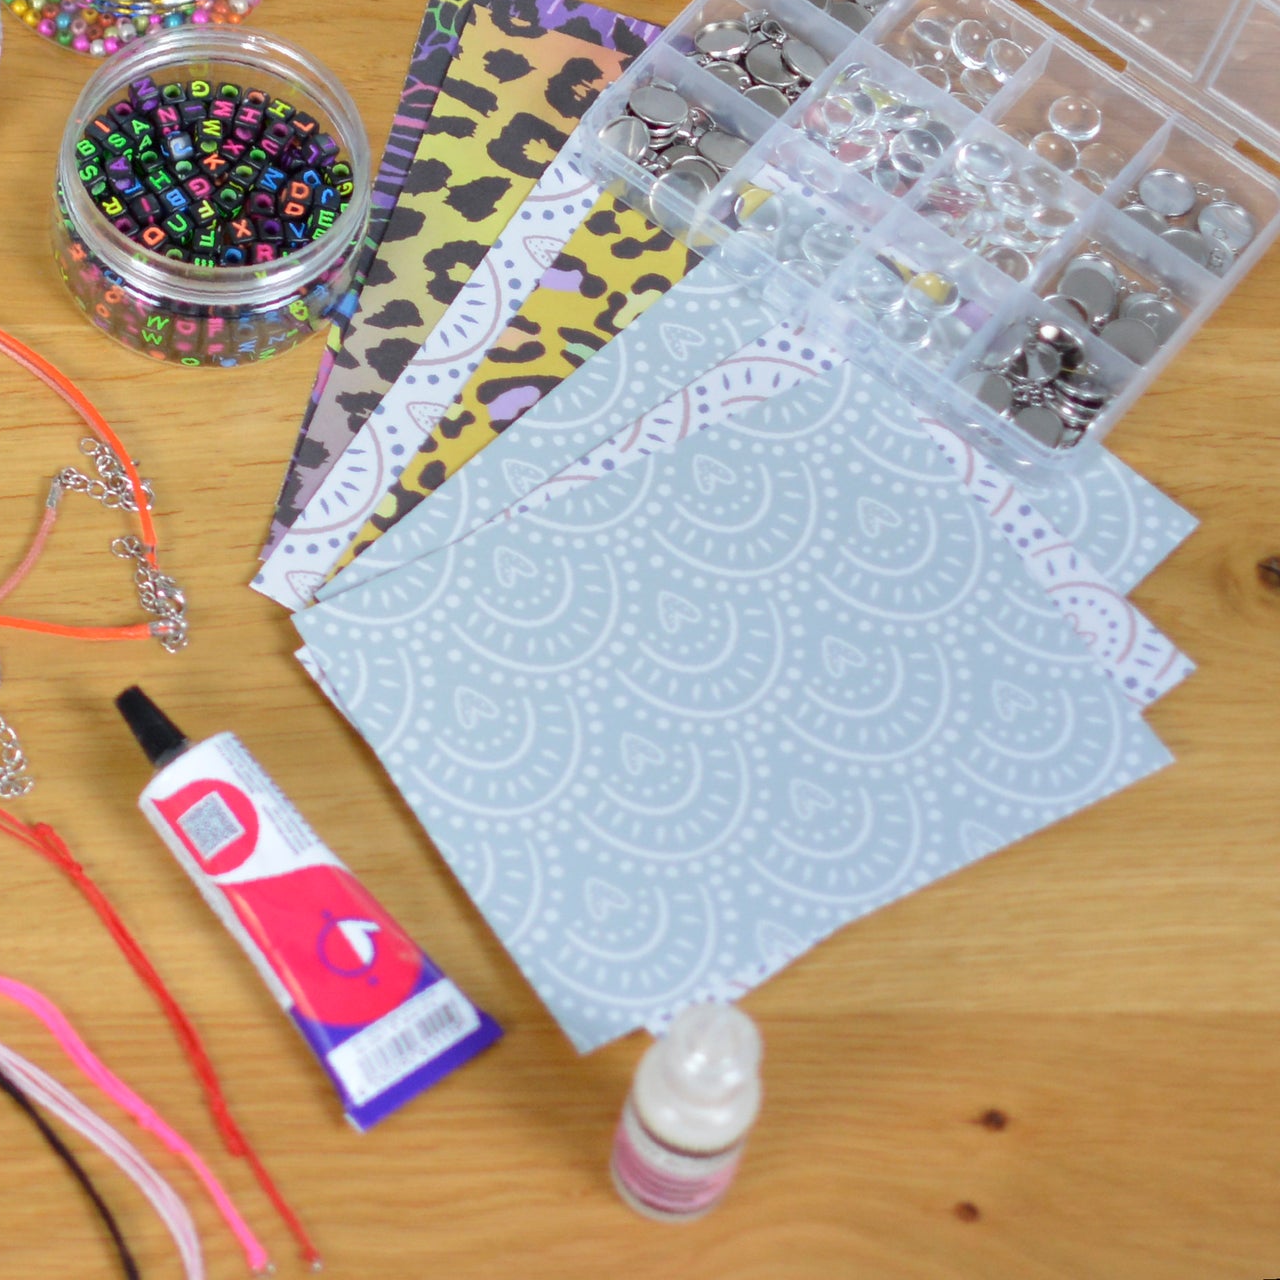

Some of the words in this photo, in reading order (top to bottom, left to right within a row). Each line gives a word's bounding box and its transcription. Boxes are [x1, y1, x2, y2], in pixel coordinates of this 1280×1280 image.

[240, 107, 262, 124] H
[268, 100, 292, 118] H
[131, 119, 151, 135] A
[76, 139, 97, 157] B
[107, 133, 127, 149] S
[222, 139, 245, 156] X
[109, 156, 129, 171] A
[203, 153, 226, 171] K
[79, 165, 99, 181] S
[148, 169, 172, 190] H
[188, 177, 212, 197] G
[290, 181, 311, 200] D
[101, 196, 124, 216] R
[165, 188, 188, 208] B
[198, 199, 216, 219] F
[284, 201, 306, 217] D
[167, 213, 189, 233] U
[318, 209, 336, 228] E
[142, 226, 167, 246] D
[231, 218, 253, 239] X
[289, 222, 307, 239] V
[199, 230, 216, 248] F
